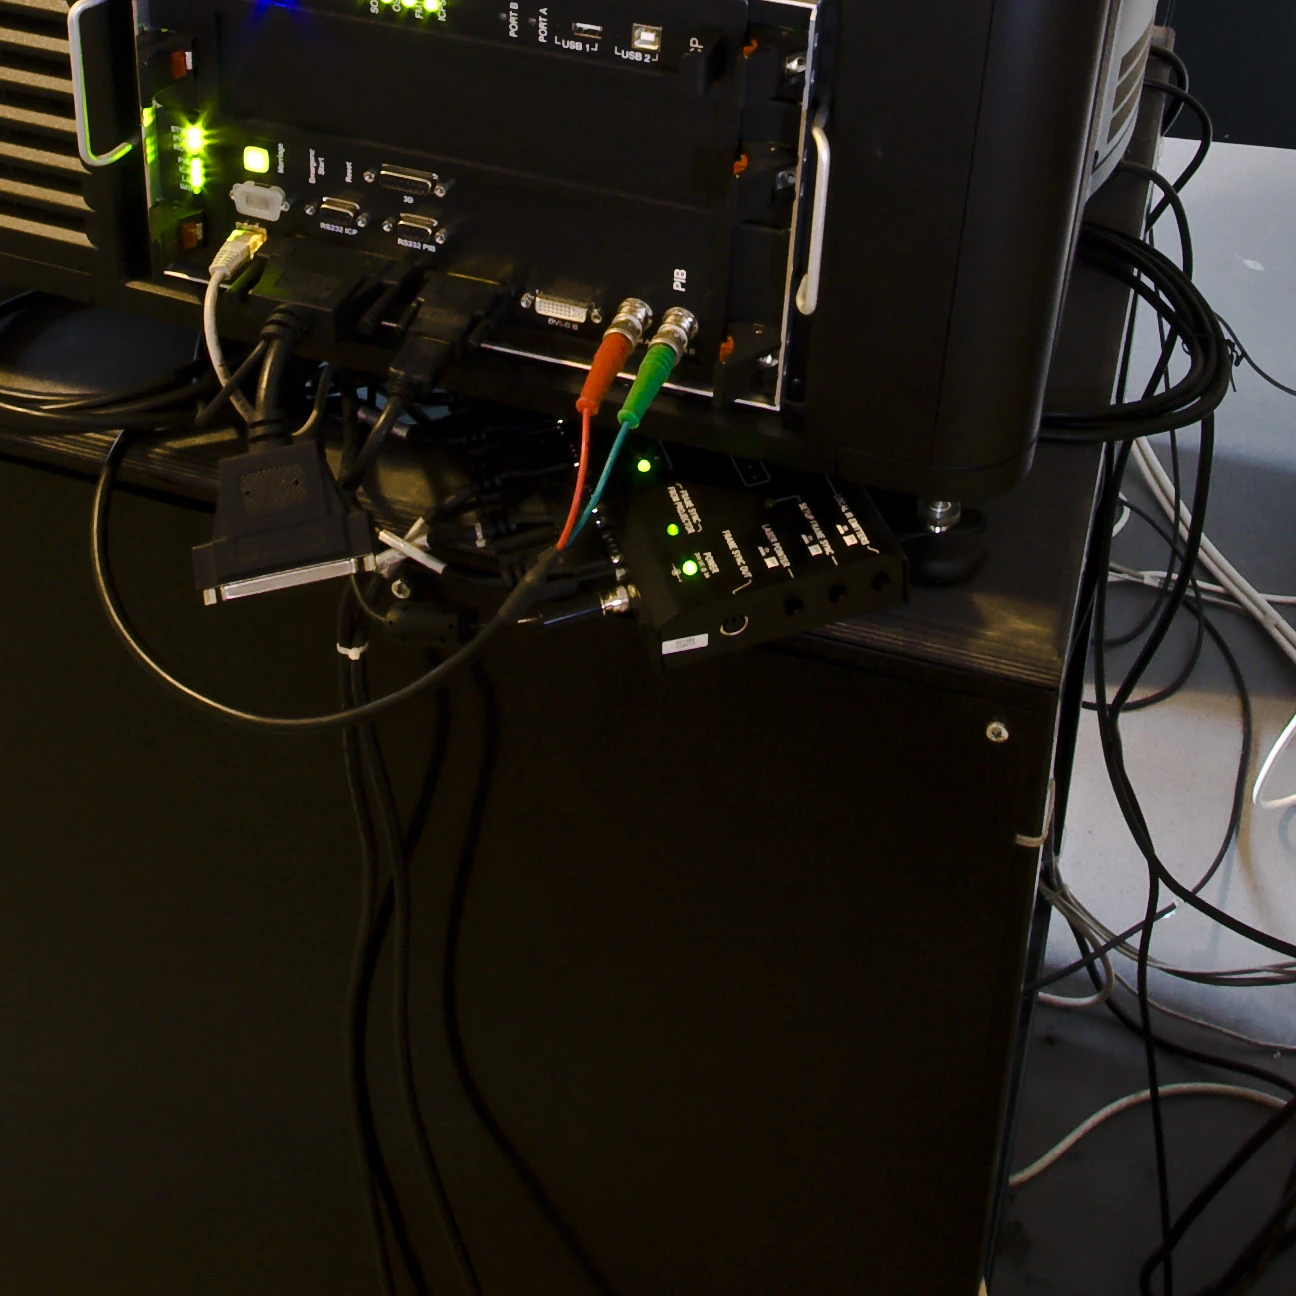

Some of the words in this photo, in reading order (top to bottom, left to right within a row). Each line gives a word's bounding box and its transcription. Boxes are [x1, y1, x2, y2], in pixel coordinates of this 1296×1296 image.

[509, 1, 519, 10] B
[538, 7, 548, 16] A
[509, 11, 519, 38] PORT
[538, 16, 548, 43] PORT
[561, 40, 583, 52] USB
[621, 51, 642, 63] USB
[644, 53, 651, 63] 2
[319, 222, 343, 234] RS232
[344, 227, 358, 237] ICP
[397, 238, 421, 250] RS232
[672, 268, 687, 292] PIB
[667, 486, 681, 502] FROM
[673, 501, 696, 535] PROJECTOR
[679, 489, 695, 508] FRAME
[687, 507, 702, 524] SYNC
[798, 502, 814, 521] SETUP
[809, 520, 826, 540] FRAME
[819, 539, 835, 556] SYNC
[848, 517, 870, 546] EMITTERS
[721, 529, 739, 551] FRAME
[731, 549, 746, 566] SYNC
[739, 565, 753, 578] OUT
[761, 524, 778, 543] LASER
[772, 542, 791, 568] POINTER
[702, 551, 720, 574] POWER
